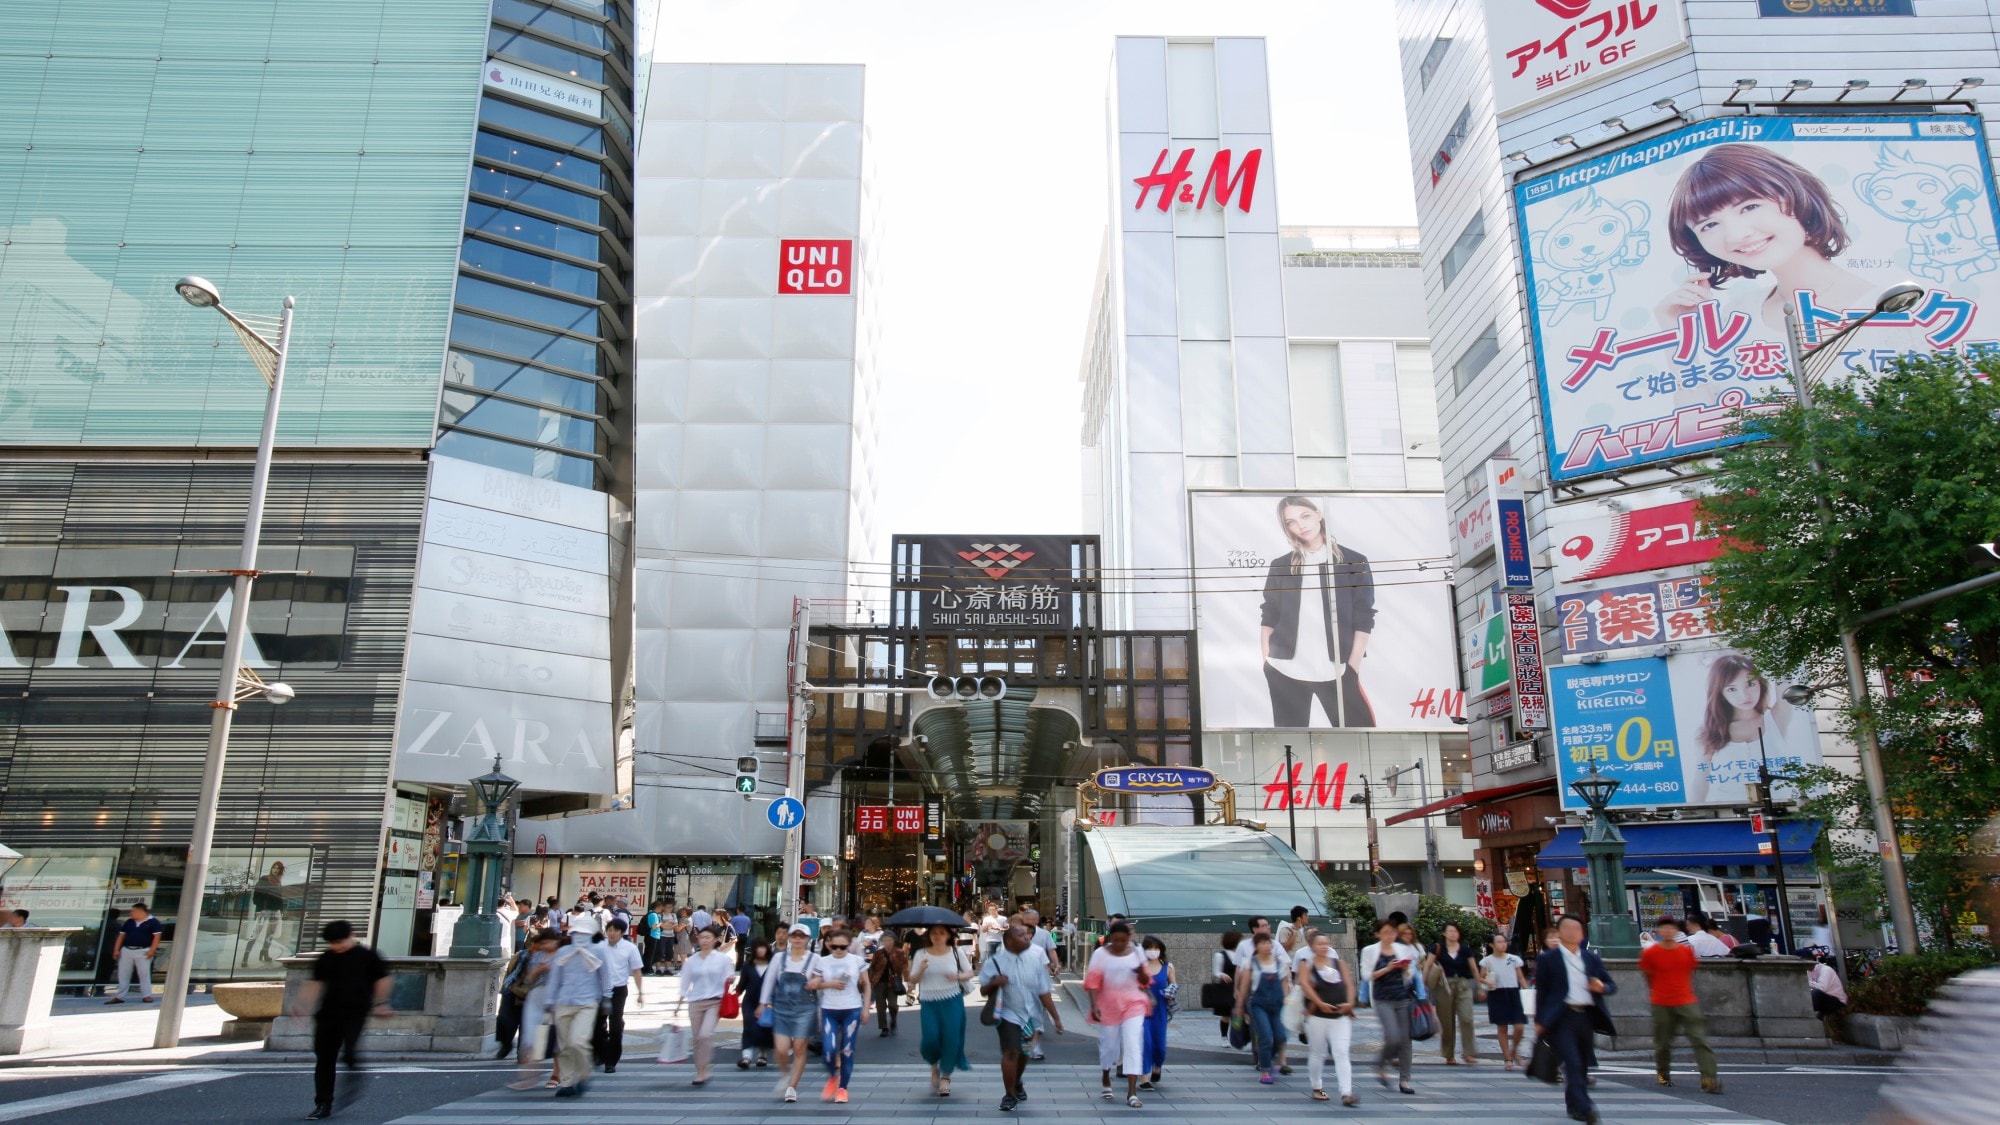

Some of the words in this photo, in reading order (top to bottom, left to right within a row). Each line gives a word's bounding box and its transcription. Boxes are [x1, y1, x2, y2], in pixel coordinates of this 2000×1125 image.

[1506, 0, 1658, 79] アイフル
[1536, 59, 1591, 91] 当ビル
[1599, 39, 1636, 66] 6F
[510, 77, 593, 109] 山田兄弟歯科
[1798, 125, 1876, 135] ハッピーメール
[1930, 124, 1960, 134] 検索
[1557, 121, 1763, 189] http://happymail.jp
[1133, 148, 1262, 213] H&M
[788, 246, 839, 265] UNI
[1847, 258, 1895, 269] 高松リナ
[787, 268, 843, 291] QLO
[1793, 289, 1978, 350] トーク
[1562, 300, 1751, 393] メール
[1505, 511, 1524, 562] PROMISE
[932, 584, 1060, 610] 心斎橋筋
[1508, 594, 1534, 604] 2F
[0, 585, 277, 669] RA
[932, 613, 960, 625] SHIN
[1567, 672, 1652, 689] 脱毛専門サロン
[1409, 688, 1464, 719] H&M
[1520, 695, 1545, 709] 免税
[1577, 694, 1646, 709] KIREIMO
[405, 708, 603, 768] ZARA
[1562, 734, 1614, 745] 月額プラン
[1577, 761, 1664, 774] キンペーン実施中
[1128, 772, 1183, 782] CRYSTA
[1262, 762, 1348, 812] H&M
[860, 809, 883, 819] ユニ
[896, 810, 919, 819] UNI
[860, 820, 883, 829] クロ
[896, 820, 920, 831] QLO
[666, 867, 688, 875] NEW
[690, 867, 715, 875] LOOK.
[580, 876, 606, 887] TAX
[610, 876, 647, 887] FREE
